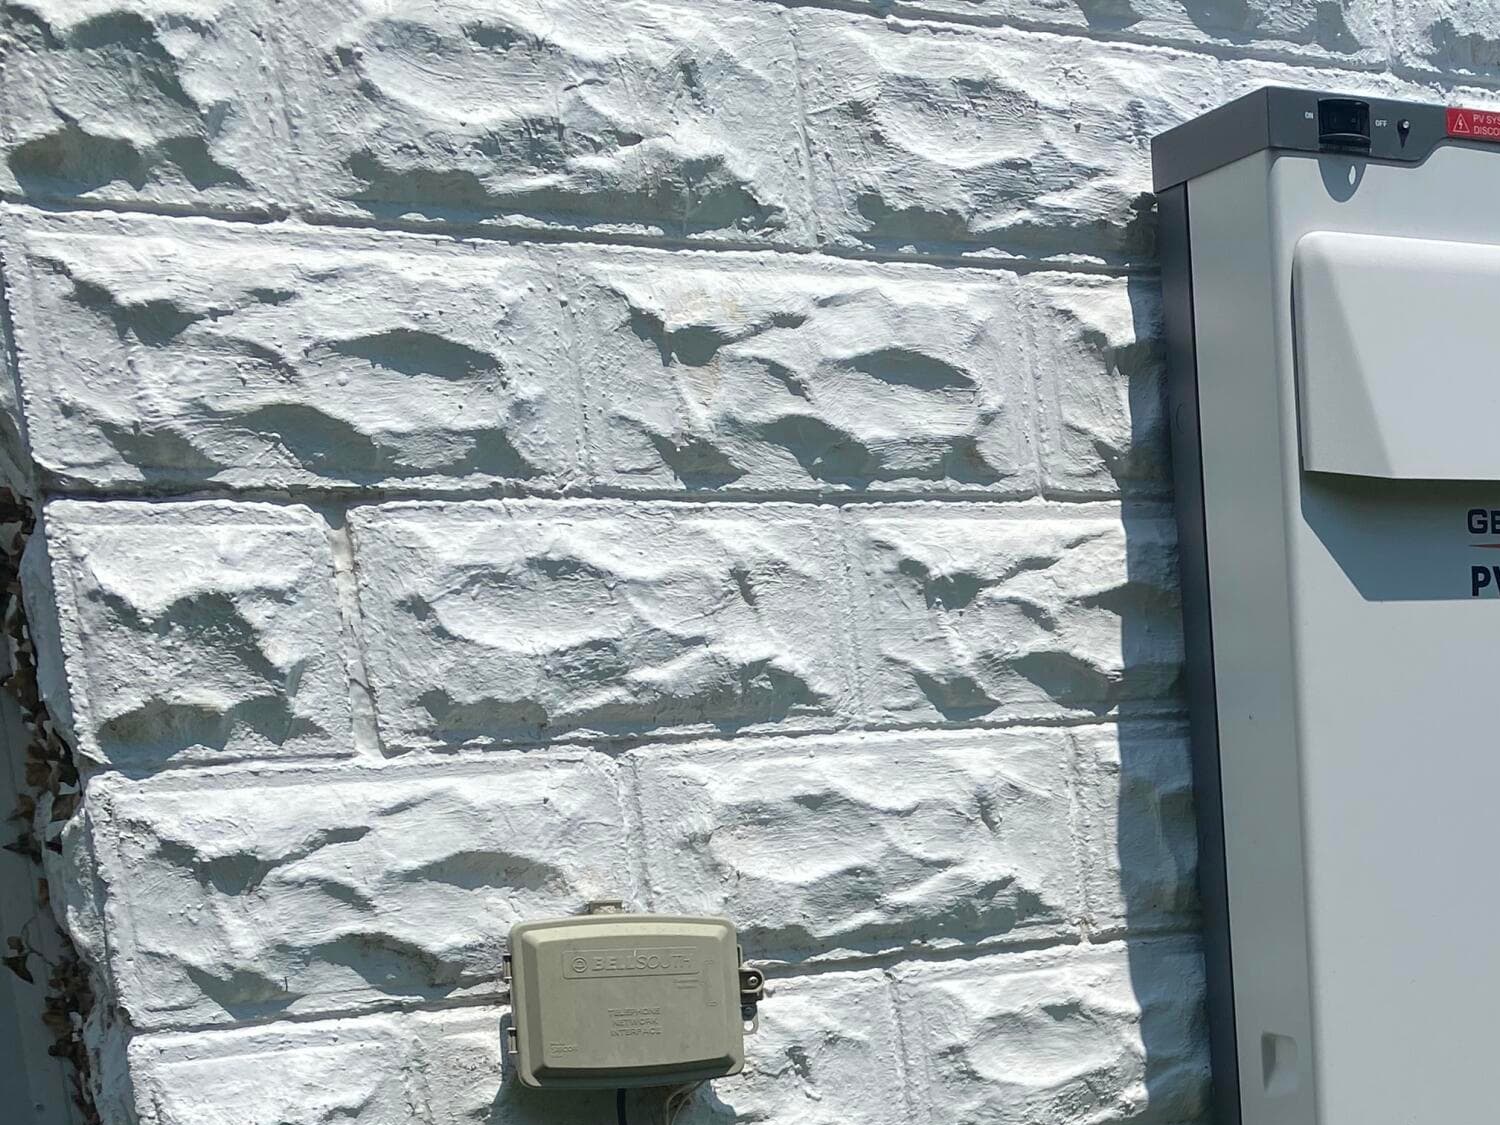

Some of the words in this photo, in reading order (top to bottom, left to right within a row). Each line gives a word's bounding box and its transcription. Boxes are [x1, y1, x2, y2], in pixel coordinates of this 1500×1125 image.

[1304, 111, 1314, 119] ON
[1472, 113, 1485, 124] PV
[1374, 119, 1387, 127] OFF
[591, 953, 692, 971] BELLSOUTH
[607, 1007, 661, 1018] TELEPHONE
[612, 1017, 659, 1027] NETWORK
